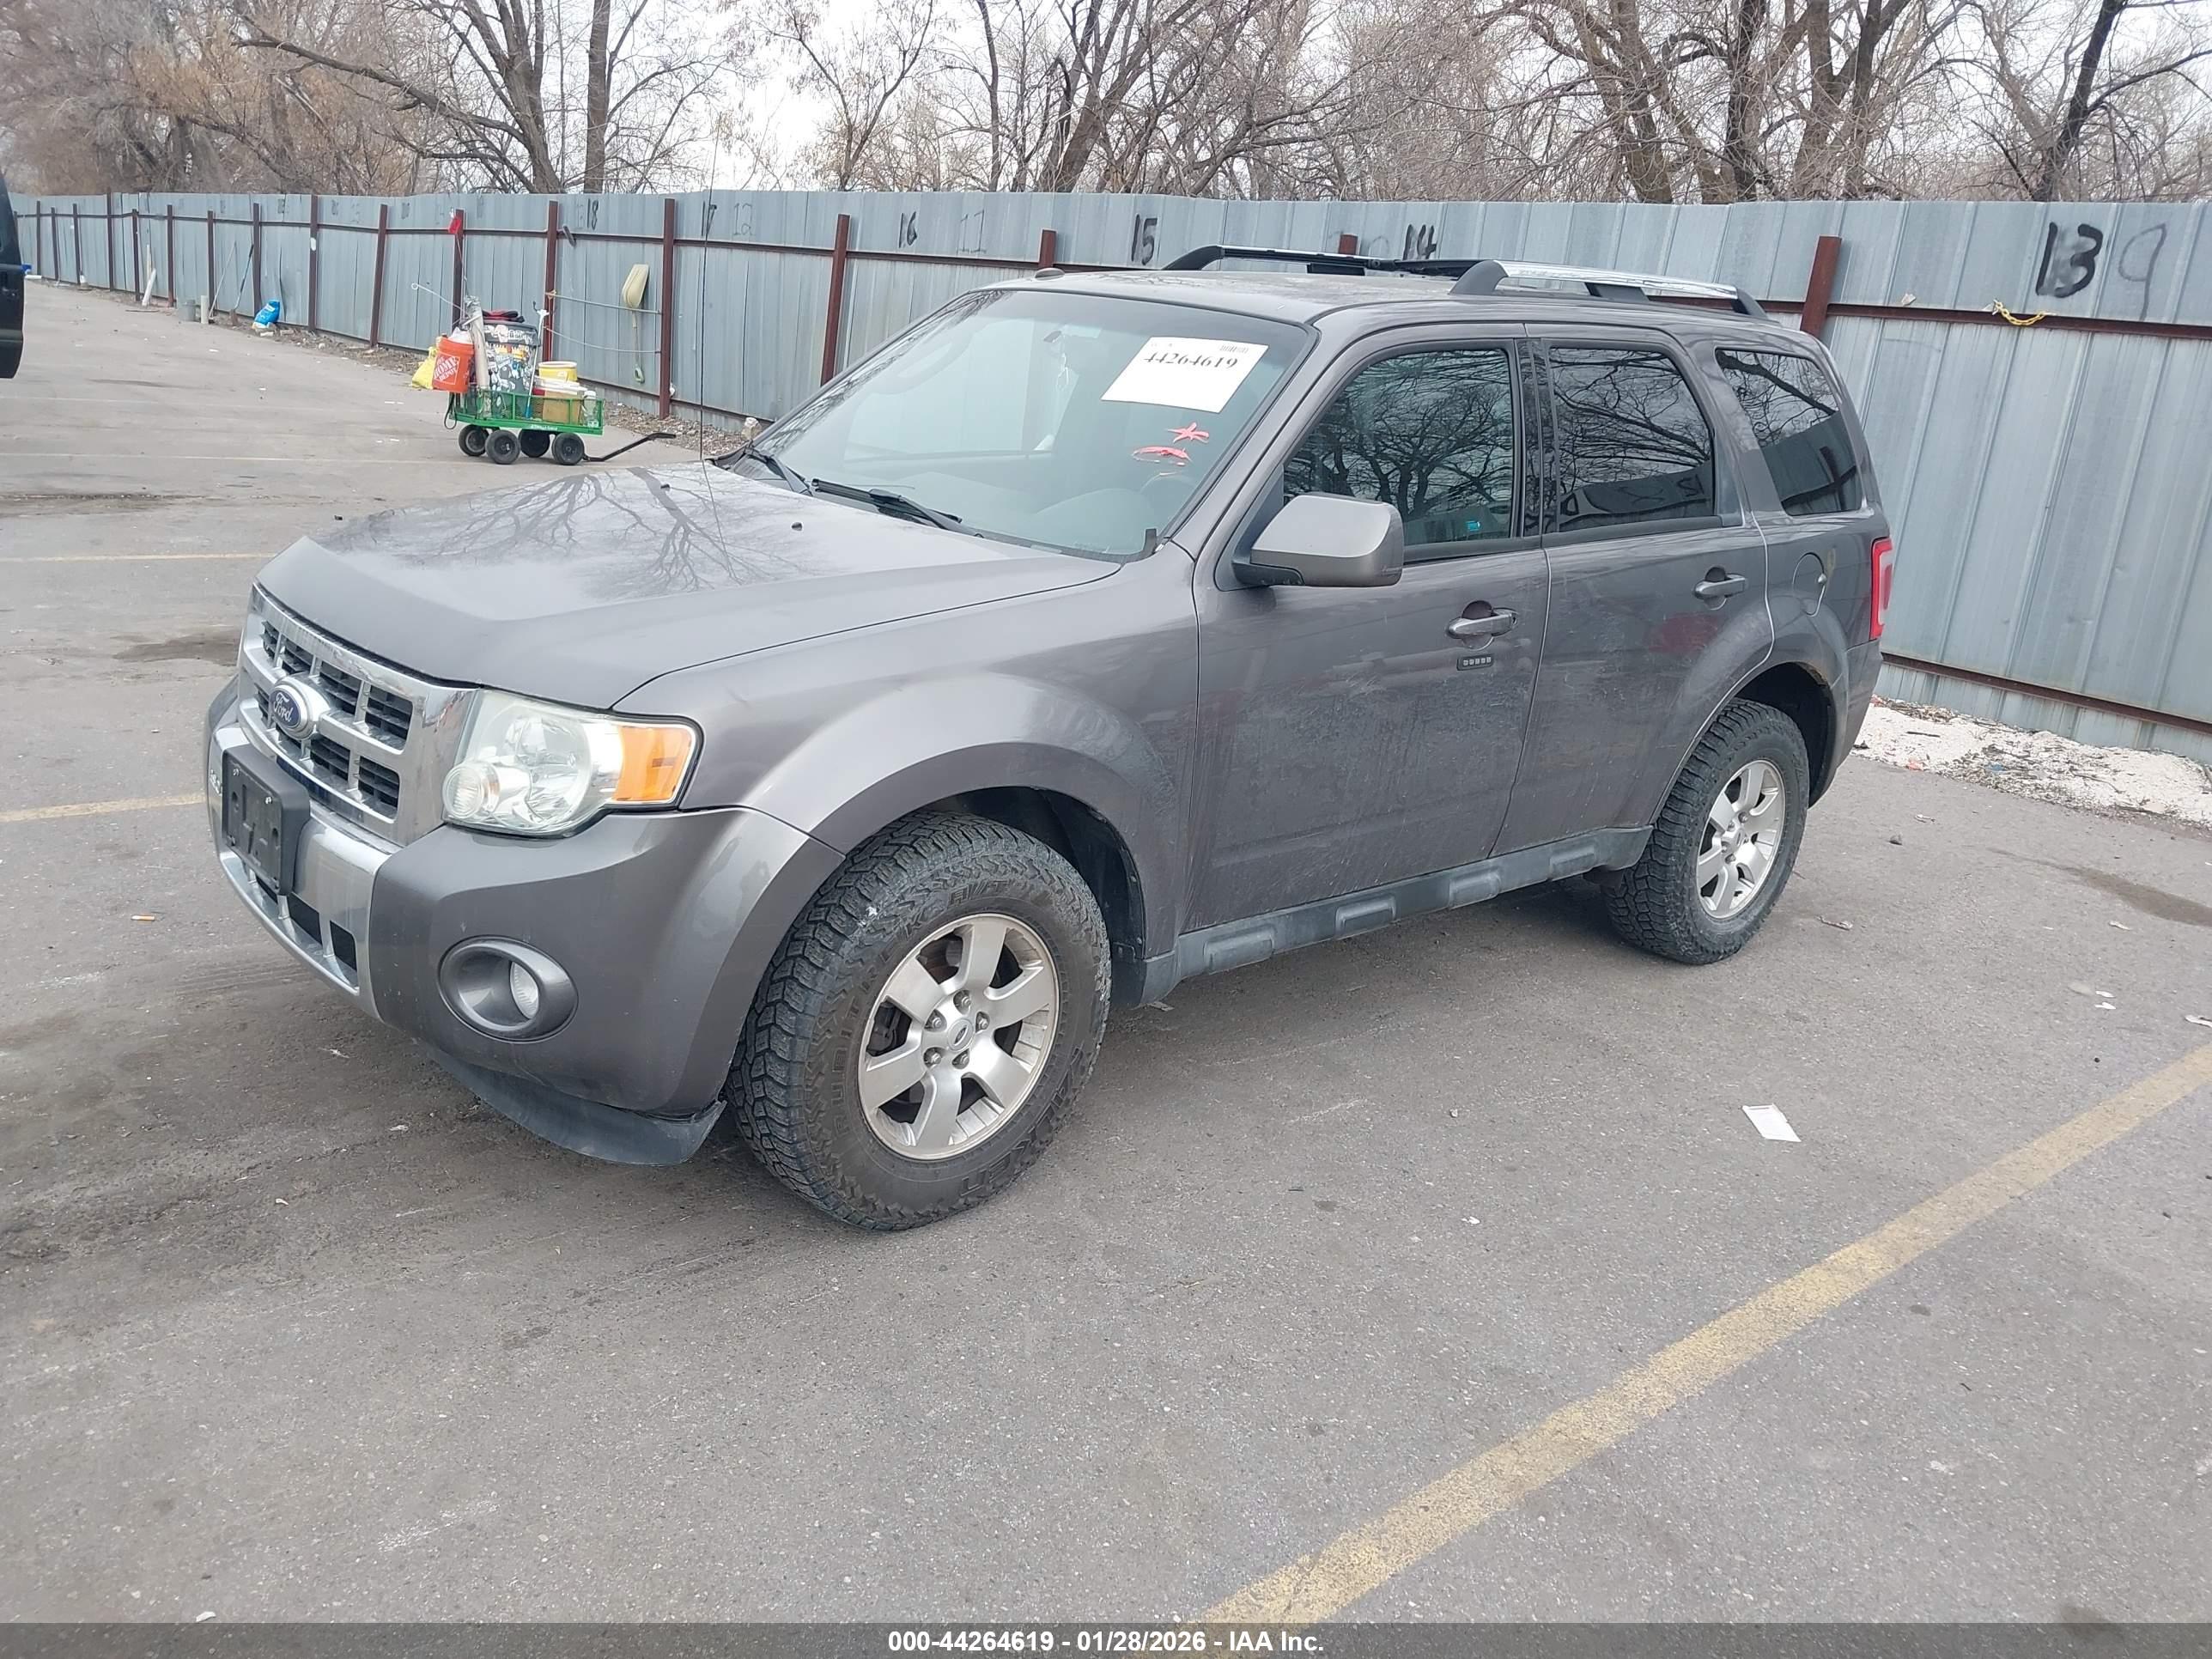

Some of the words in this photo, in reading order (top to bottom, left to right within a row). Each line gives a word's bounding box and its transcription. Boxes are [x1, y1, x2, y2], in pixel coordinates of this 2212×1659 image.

[586, 198, 600, 231] 18
[898, 211, 918, 249] 16
[1131, 213, 1158, 266] 15
[1402, 222, 1438, 260] 14
[2035, 221, 2104, 299] 13
[1143, 351, 1239, 369] 44264619
[273, 691, 295, 722] Ford
